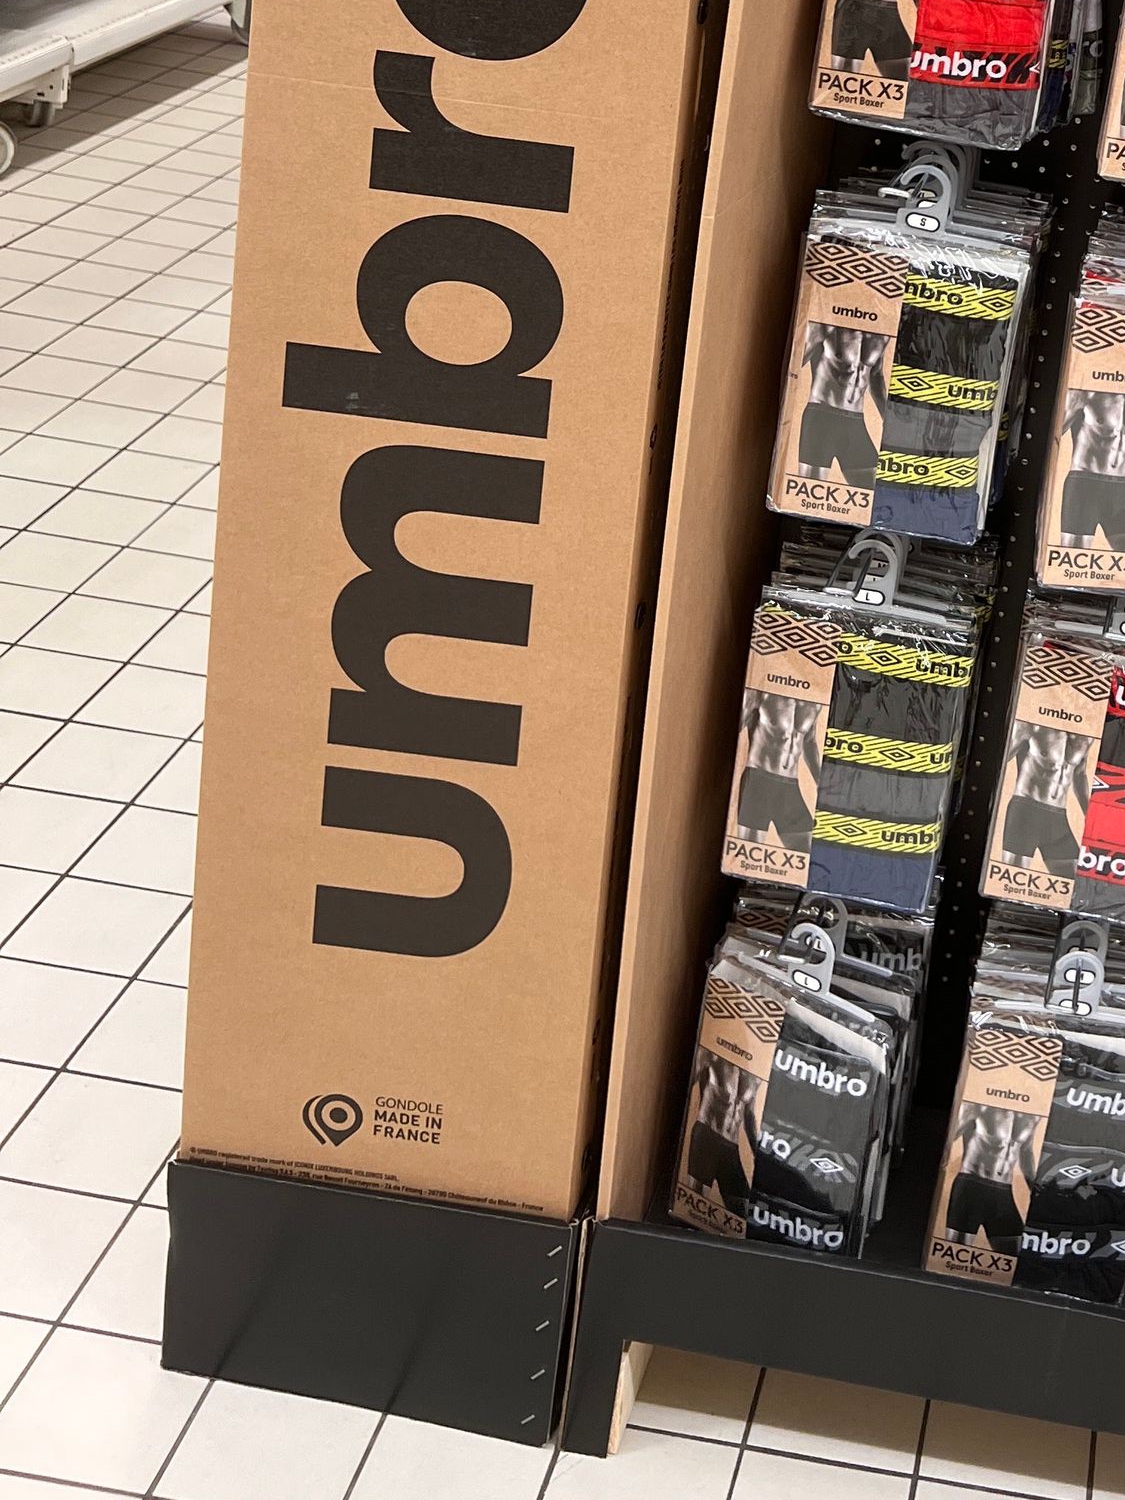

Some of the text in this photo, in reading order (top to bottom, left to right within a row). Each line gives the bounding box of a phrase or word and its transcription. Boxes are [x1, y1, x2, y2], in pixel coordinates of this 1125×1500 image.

[818, 71, 904, 101] PACK X3
[834, 92, 885, 109] Sport Boxer
[920, 217, 926, 227] S
[832, 305, 877, 321] umbro
[786, 479, 869, 507] PACK X3
[801, 498, 850, 515] Sport Boxer
[1048, 550, 1101, 571] PACK
[1064, 569, 1114, 581] Sport Boxer
[865, 593, 870, 601] L
[767, 672, 810, 690] umbro
[1038, 705, 1083, 723] umbro
[726, 841, 806, 870] PACK X3
[989, 865, 1070, 894] PACK X3
[716, 1037, 753, 1061] umbro
[775, 1049, 867, 1096] umbro
[986, 1087, 1030, 1102] umbro
[376, 1096, 443, 1115] GONDOLE
[374, 1110, 442, 1130] MADE IN
[373, 1125, 440, 1144] FRANCE
[677, 1187, 744, 1234] PACK X3
[754, 1205, 843, 1248] umbro
[932, 1242, 1013, 1272] PACK X3
